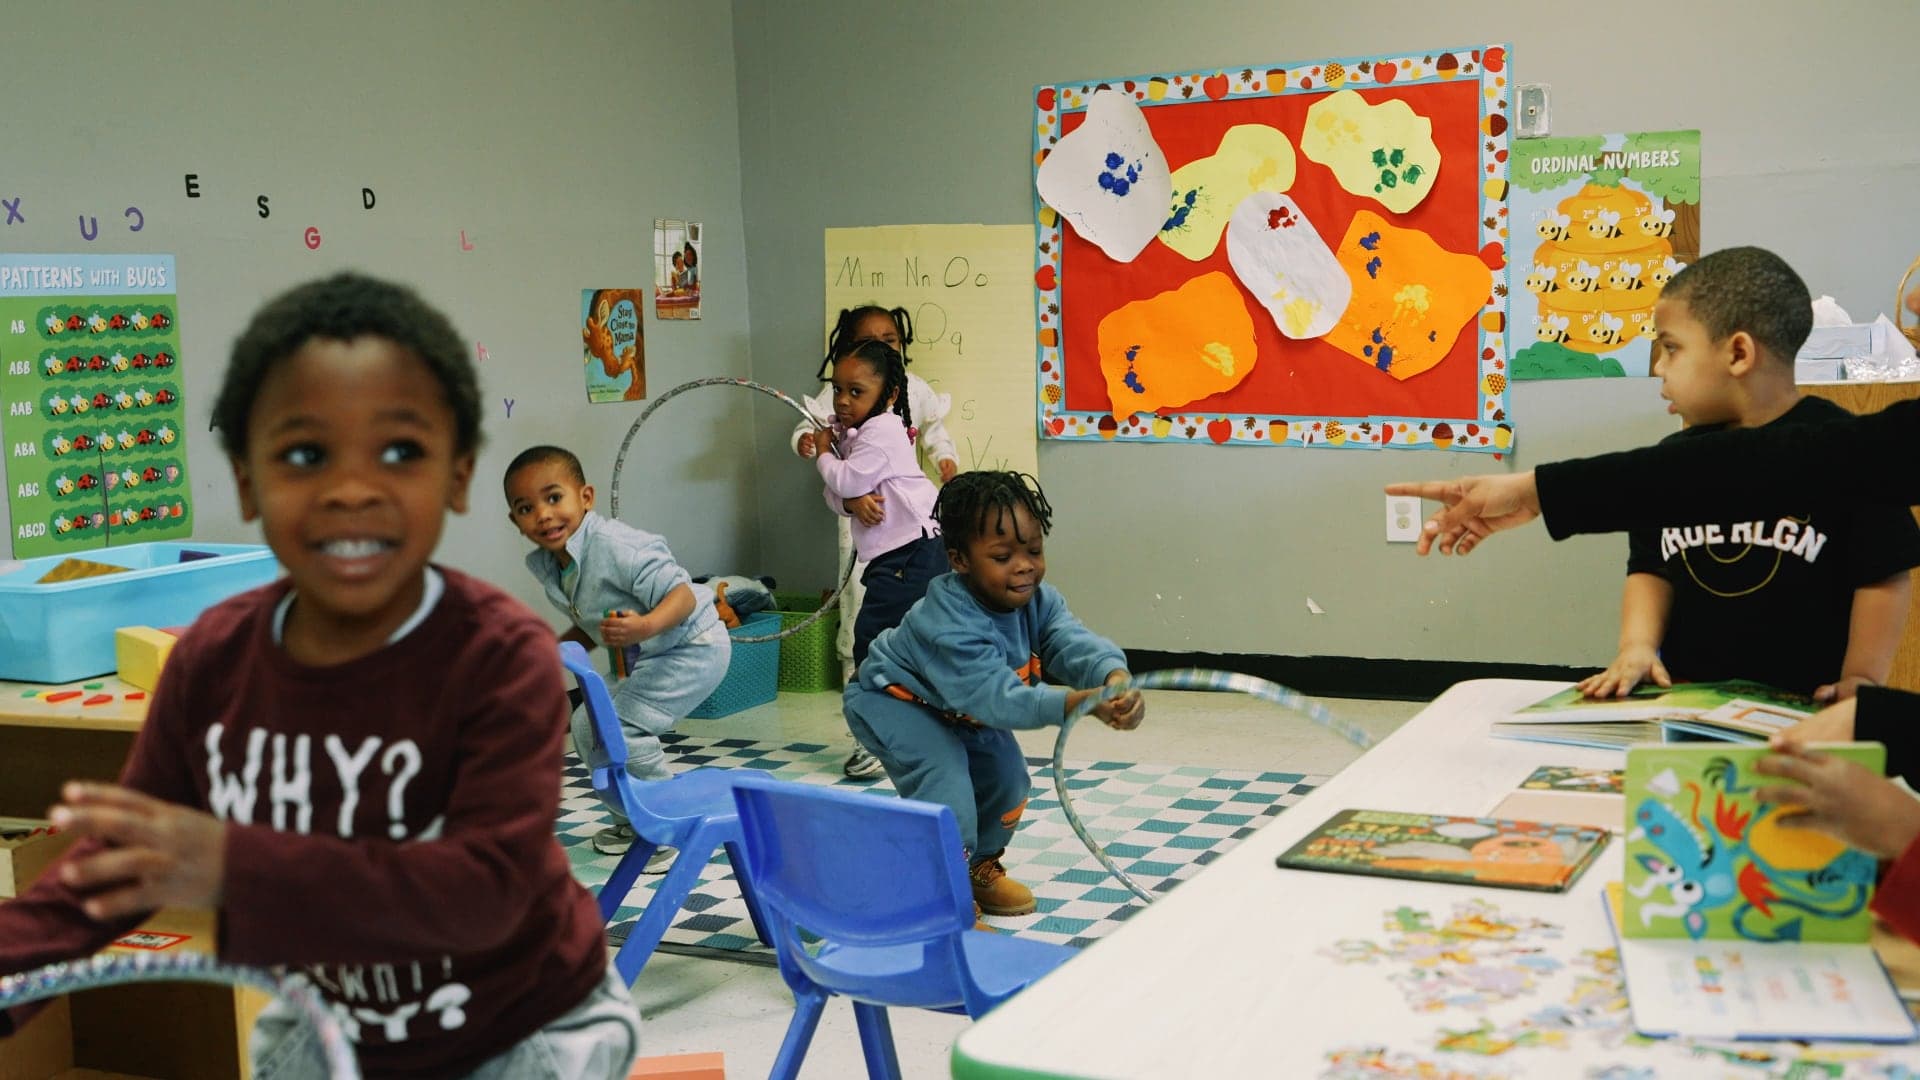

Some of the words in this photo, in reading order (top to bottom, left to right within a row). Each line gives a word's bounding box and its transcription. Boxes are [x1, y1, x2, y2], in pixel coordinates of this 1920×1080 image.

[1531, 155, 1598, 174] ORDINAL
[1603, 149, 1681, 171] NUMBERS
[184, 174, 201, 198] E
[256, 195, 270, 219] S
[362, 187, 376, 210] D
[2, 197, 25, 225] X
[79, 215, 98, 241] U
[304, 226, 321, 250] G
[461, 229, 475, 251] L
[1, 266, 84, 289] PATTERNS
[90, 269, 120, 287] WITH
[127, 266, 167, 288] BUGS
[617, 304, 632, 319] Stay
[11, 320, 26, 334] AB
[9, 361, 31, 375] ABB
[10, 401, 33, 416] AAB
[504, 398, 515, 418] Y
[14, 442, 36, 457] ABA
[18, 483, 40, 497] ABC
[18, 523, 46, 538] ABCD
[1661, 524, 1725, 562] RUE
[205, 721, 423, 840] WHY?
